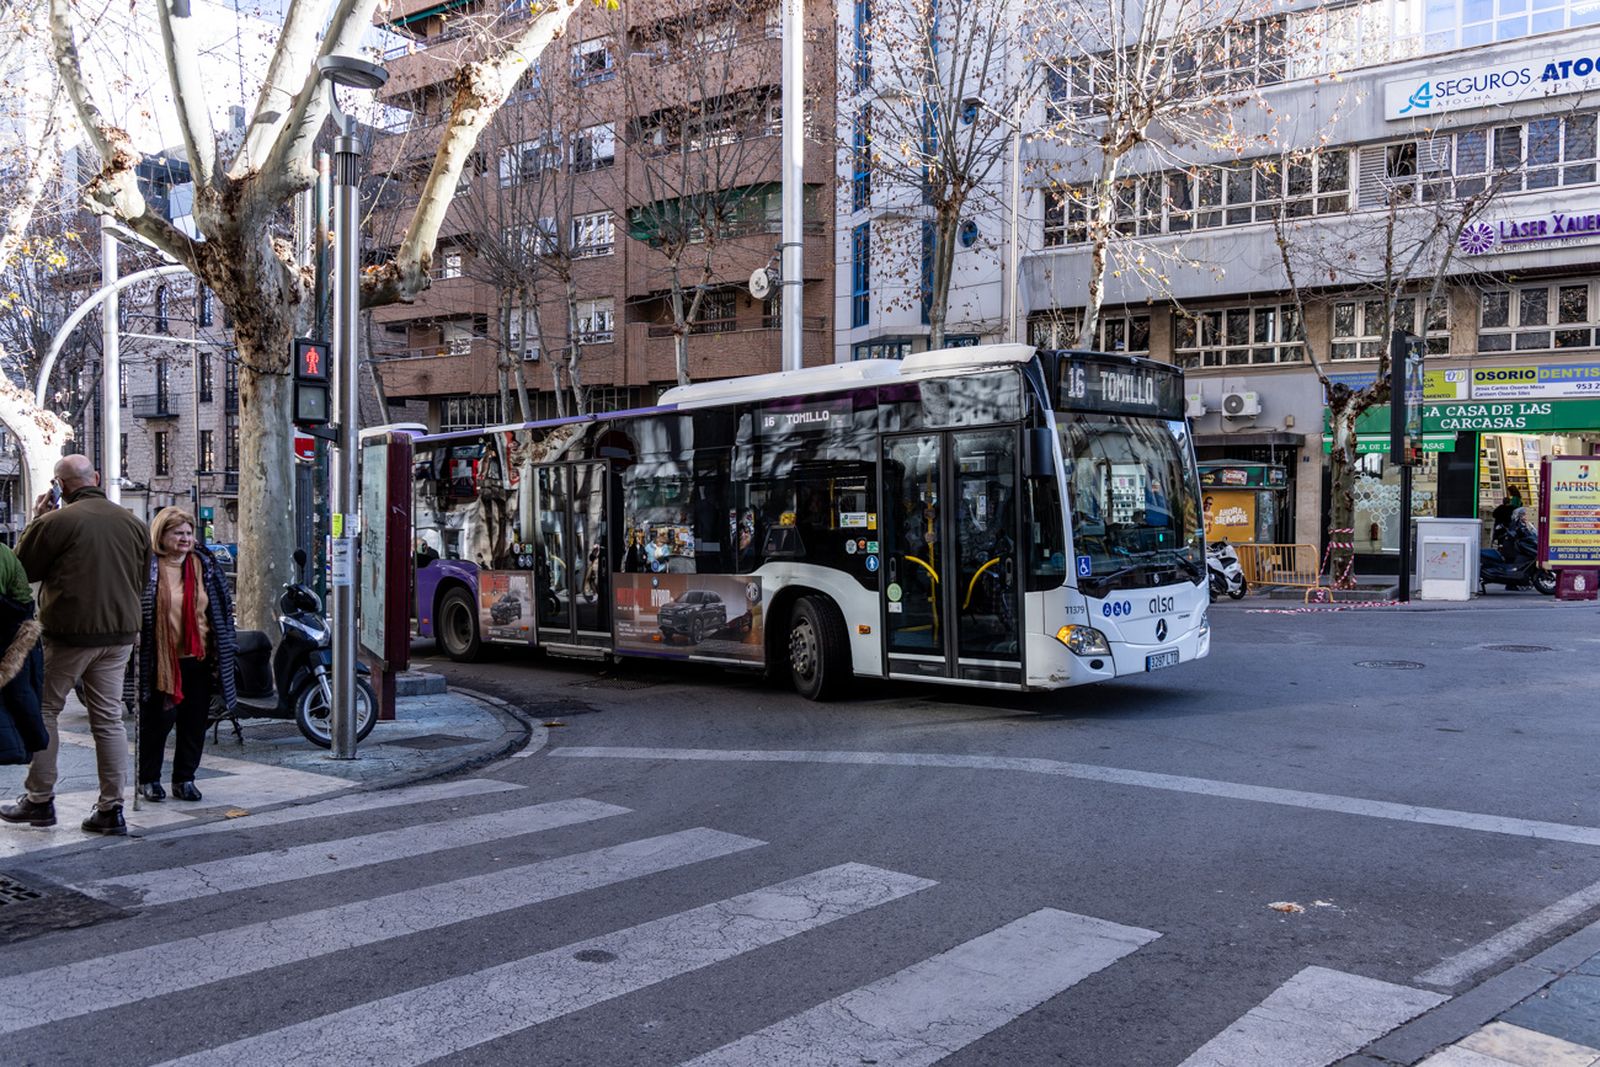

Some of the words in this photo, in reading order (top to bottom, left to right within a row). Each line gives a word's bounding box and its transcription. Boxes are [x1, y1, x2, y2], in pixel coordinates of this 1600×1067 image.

[1435, 68, 1531, 98] SEGUROS
[1475, 369, 1536, 381] OSORIO
[1067, 367, 1085, 398] 16
[1100, 371, 1153, 404] TOMILLO
[764, 416, 775, 427] 16
[786, 410, 829, 424] TOMILLO
[1446, 405, 1488, 417] CASA
[1491, 404, 1513, 415] DE
[1520, 403, 1551, 415] LAS
[1440, 417, 1526, 429] CARCASAS
[1149, 595, 1174, 614] alsa
